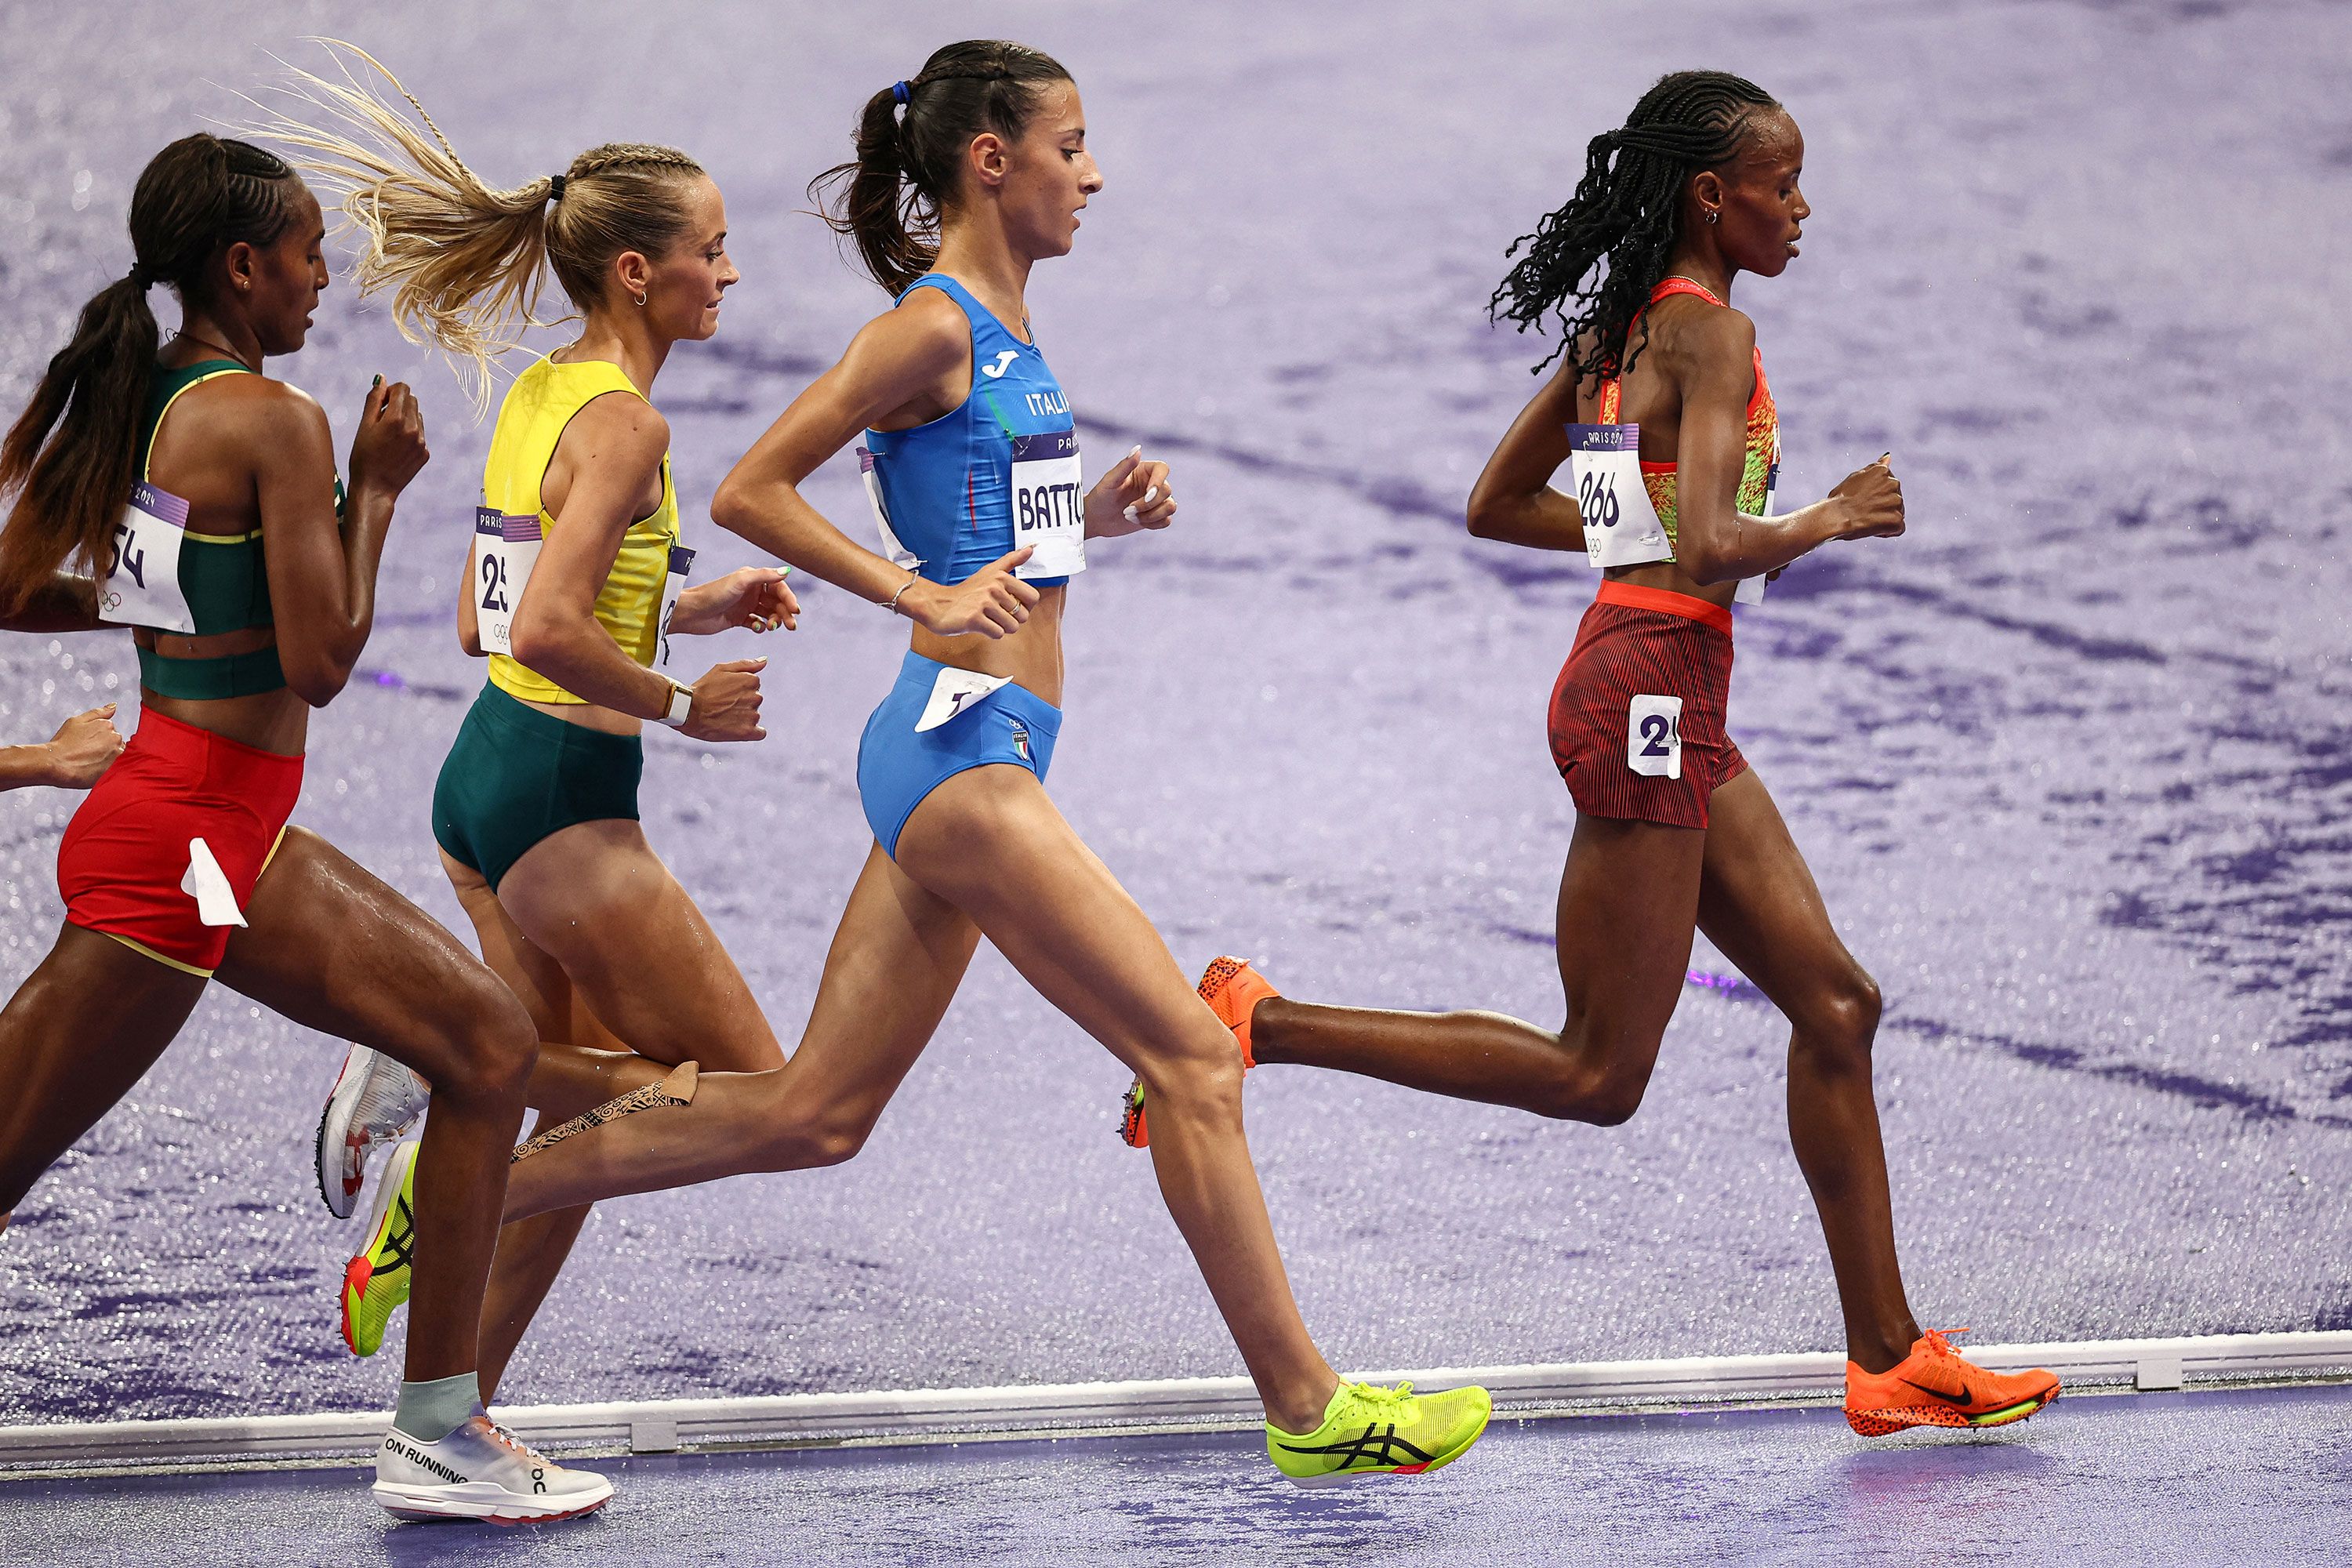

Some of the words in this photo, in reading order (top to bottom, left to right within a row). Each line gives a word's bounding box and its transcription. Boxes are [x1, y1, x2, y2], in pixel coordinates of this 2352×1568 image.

[135, 487, 155, 507] 2024
[1580, 470, 1620, 527] 266
[1639, 713, 1679, 757] 2
[385, 1438, 406, 1455] ON
